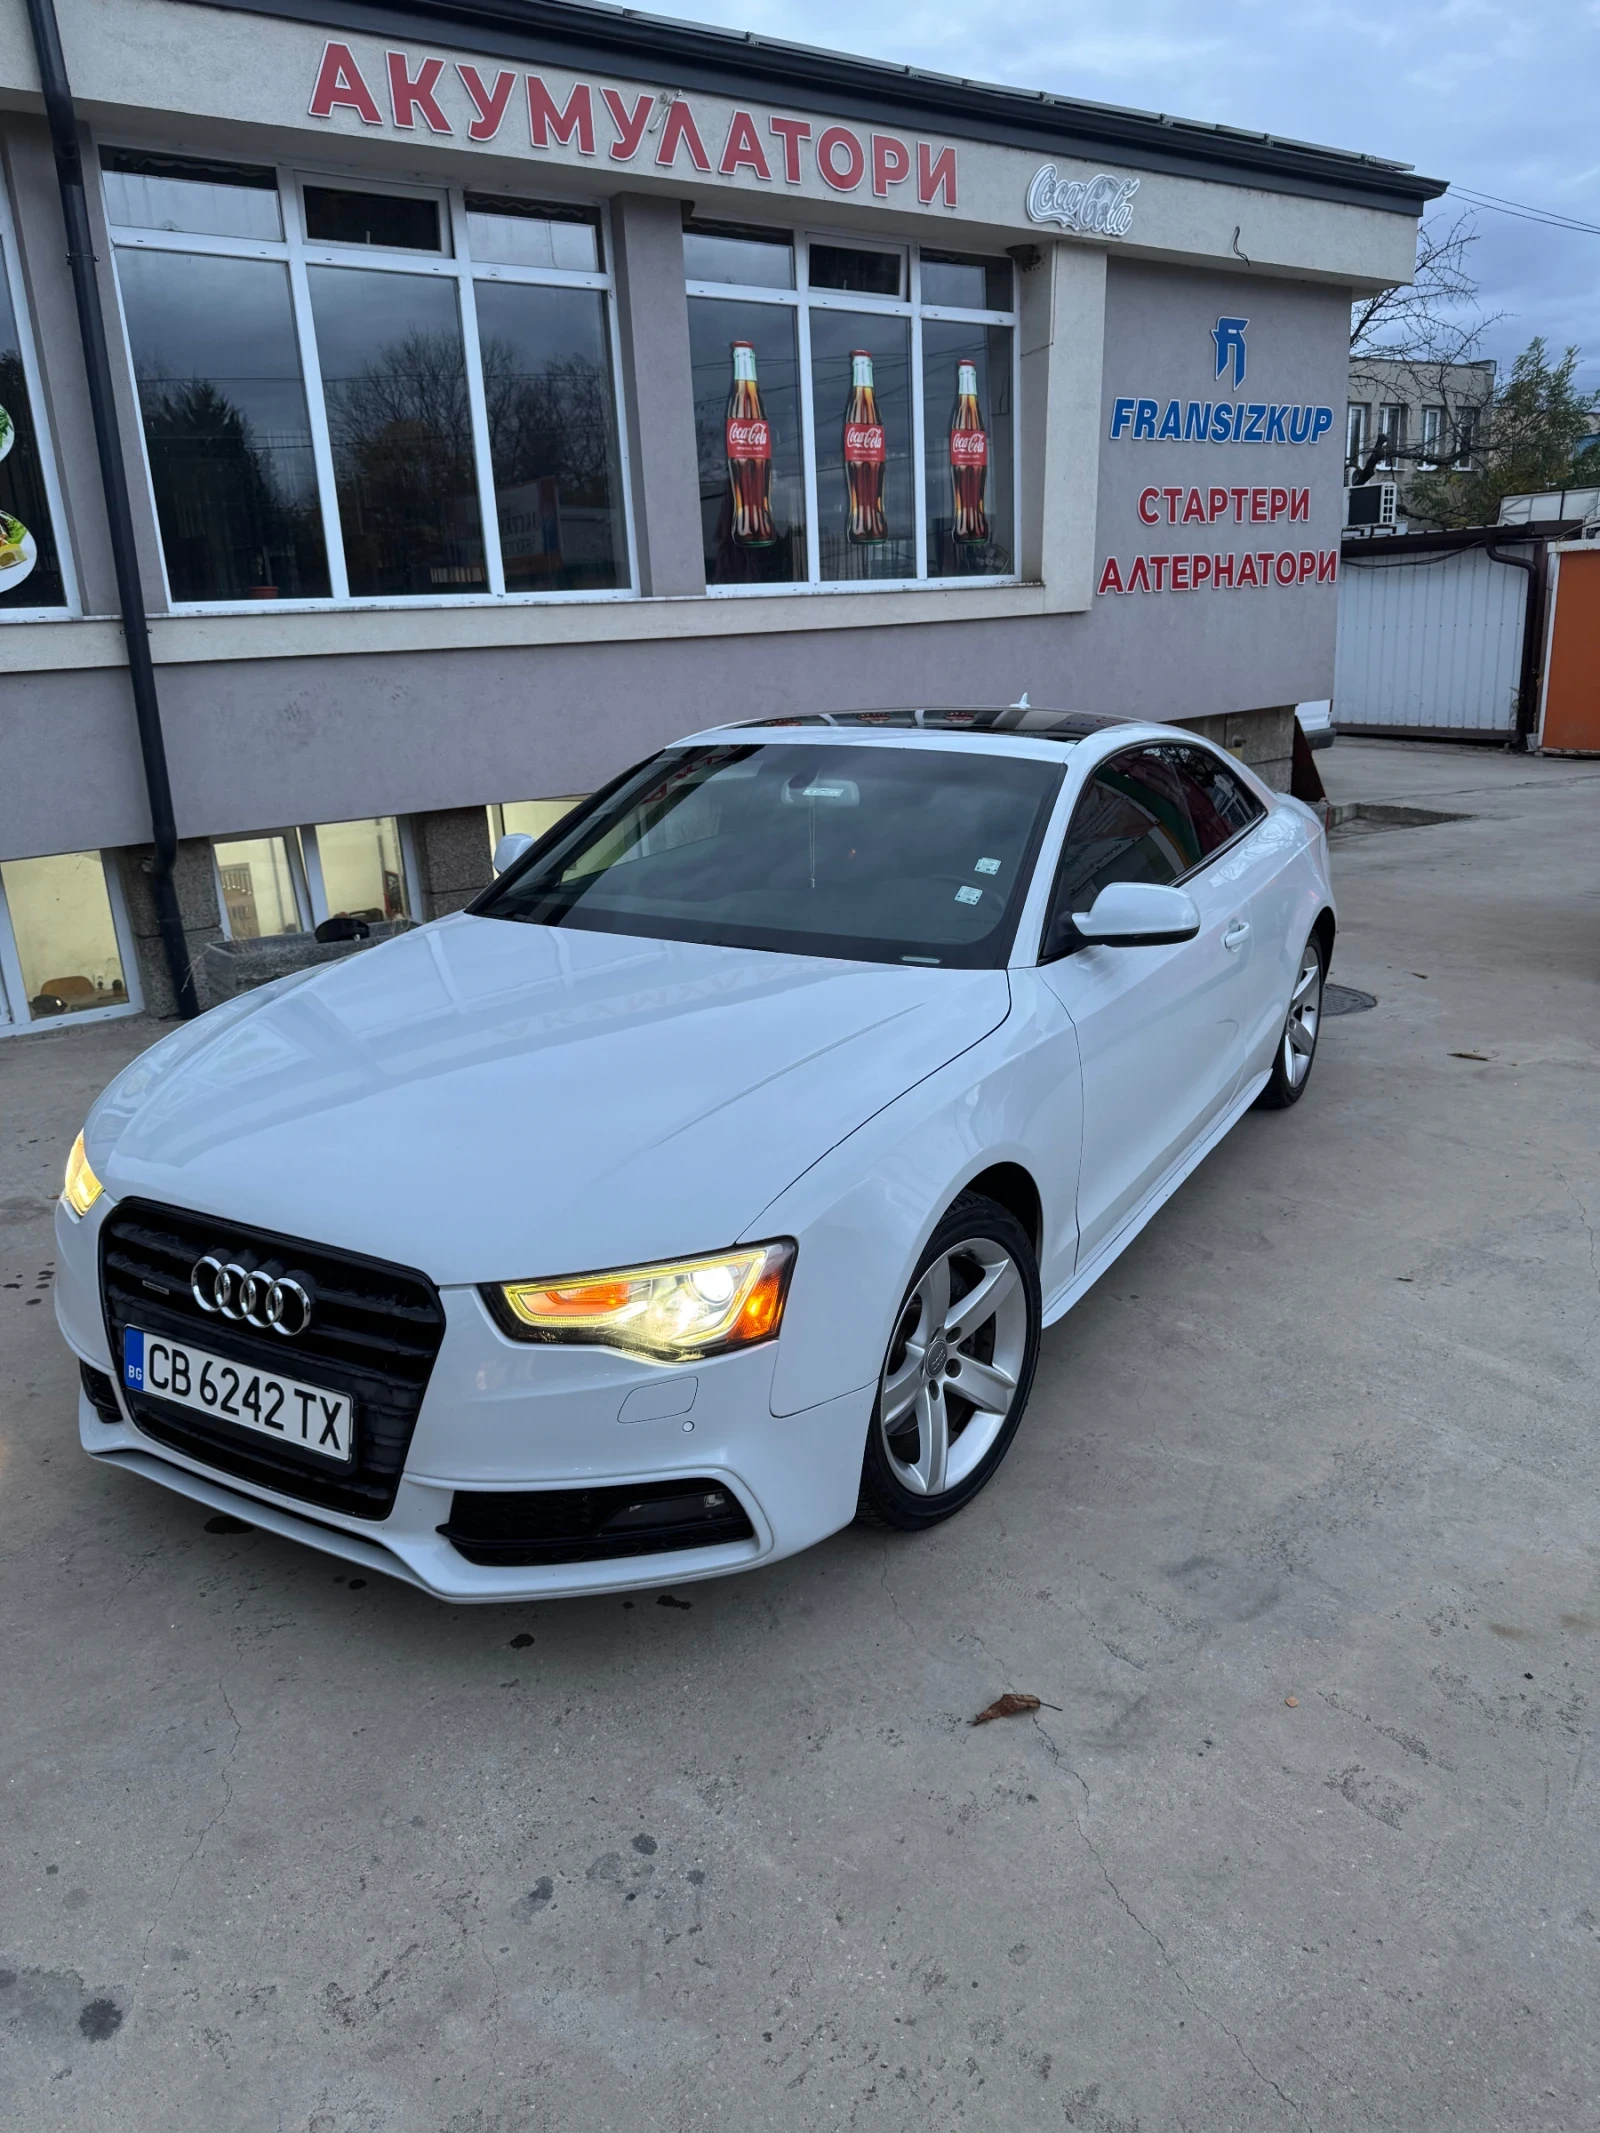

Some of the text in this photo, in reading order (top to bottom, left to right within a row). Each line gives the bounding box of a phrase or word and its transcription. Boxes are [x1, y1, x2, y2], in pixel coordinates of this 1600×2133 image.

[308, 40, 958, 208] АКУМУЛАТОРИ
[1110, 397, 1334, 444] FRANSIZKUP
[1138, 486, 1311, 525] СТАРТЕРИ
[1097, 549, 1338, 595] АЛТЕРНАТОРИ
[128, 1365, 143, 1381] BG
[200, 1361, 285, 1431] 6242
